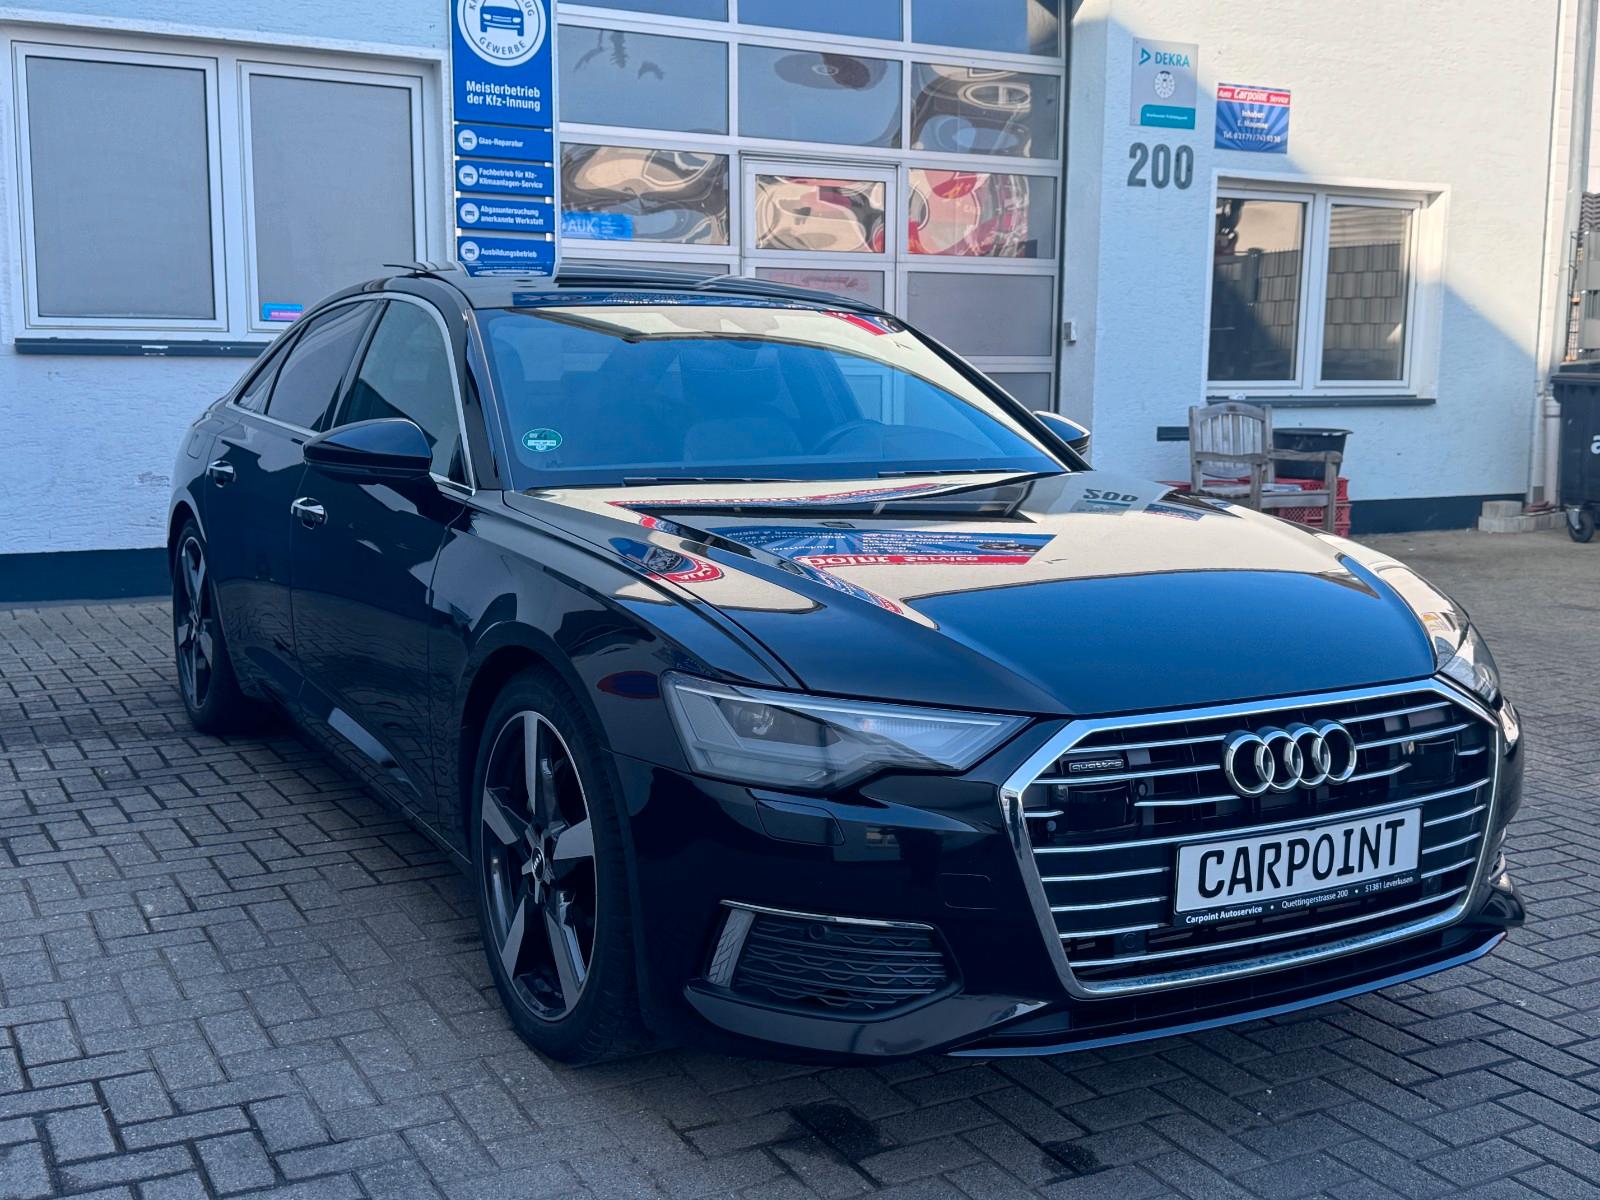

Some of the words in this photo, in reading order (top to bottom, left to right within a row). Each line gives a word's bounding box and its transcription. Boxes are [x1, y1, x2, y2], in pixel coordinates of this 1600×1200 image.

[479, 37, 525, 55] GEWERBE
[1155, 52, 1190, 67] DEKRA
[466, 80, 540, 98] Meisterbetrieb
[1233, 88, 1268, 102] Carpoint
[467, 93, 484, 105] der
[486, 95, 540, 112] Kfz-Innung
[479, 136, 524, 148] Glas-Reparatur
[479, 168, 514, 178] Fachbetrieb
[515, 170, 524, 178] für
[1127, 142, 1194, 190] 200
[479, 178, 543, 189] Klimaanlagen-Service
[480, 205, 539, 217] Abgasuntersuchung
[481, 215, 514, 224] anerkannte
[515, 217, 544, 226] Werkstatt
[480, 248, 538, 258] Ausbildungsbetrieb
[1072, 761, 1122, 771] quattro
[1197, 818, 1405, 899] CARPOINT
[1185, 911, 1219, 925] Carpoint
[1219, 905, 1263, 919] Autoservice
[1281, 892, 1336, 910] Quettingerstrasse
[1337, 889, 1349, 899] 200
[1365, 882, 1382, 893] 51381
[1383, 875, 1414, 890] Leverkusen
